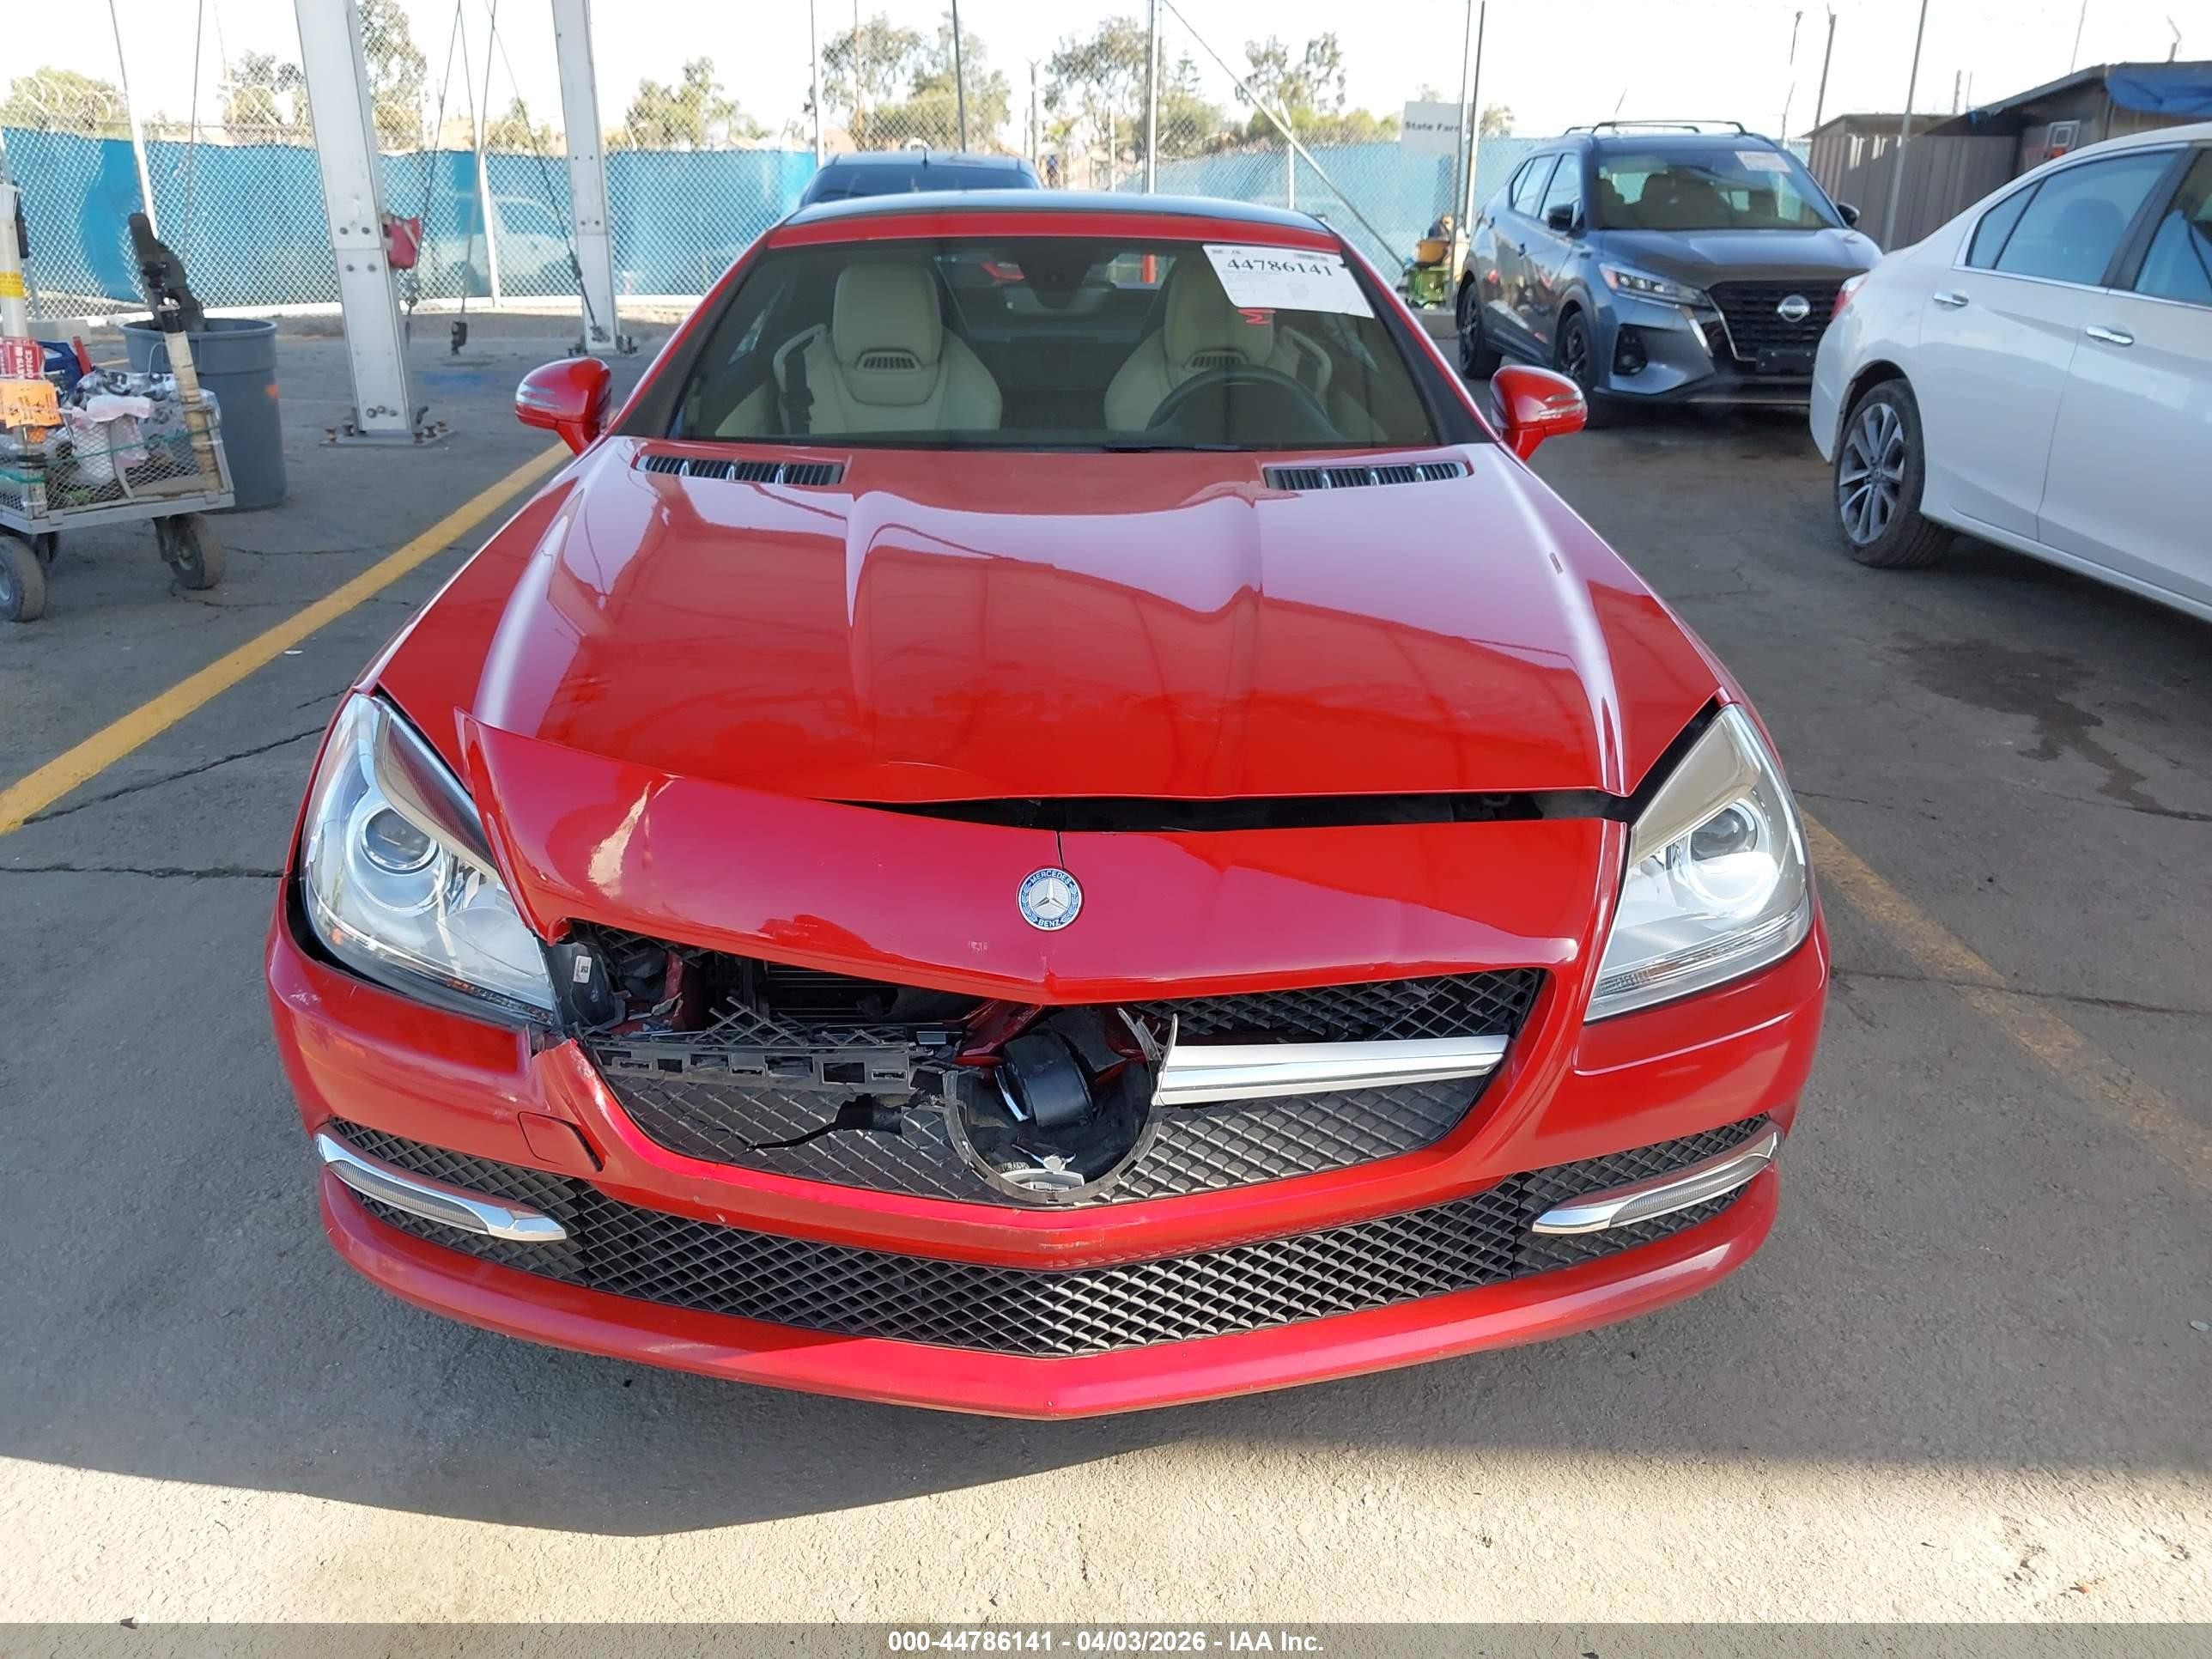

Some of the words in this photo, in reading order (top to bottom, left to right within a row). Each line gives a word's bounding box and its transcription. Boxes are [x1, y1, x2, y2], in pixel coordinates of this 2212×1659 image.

[1405, 121, 1433, 131] State
[1226, 258, 1333, 276] 44786141
[15, 346, 23, 356] IN
[25, 349, 33, 378] OFFICE
[1030, 870, 1071, 884] MERCEDES
[1037, 919, 1060, 927] BENZ
